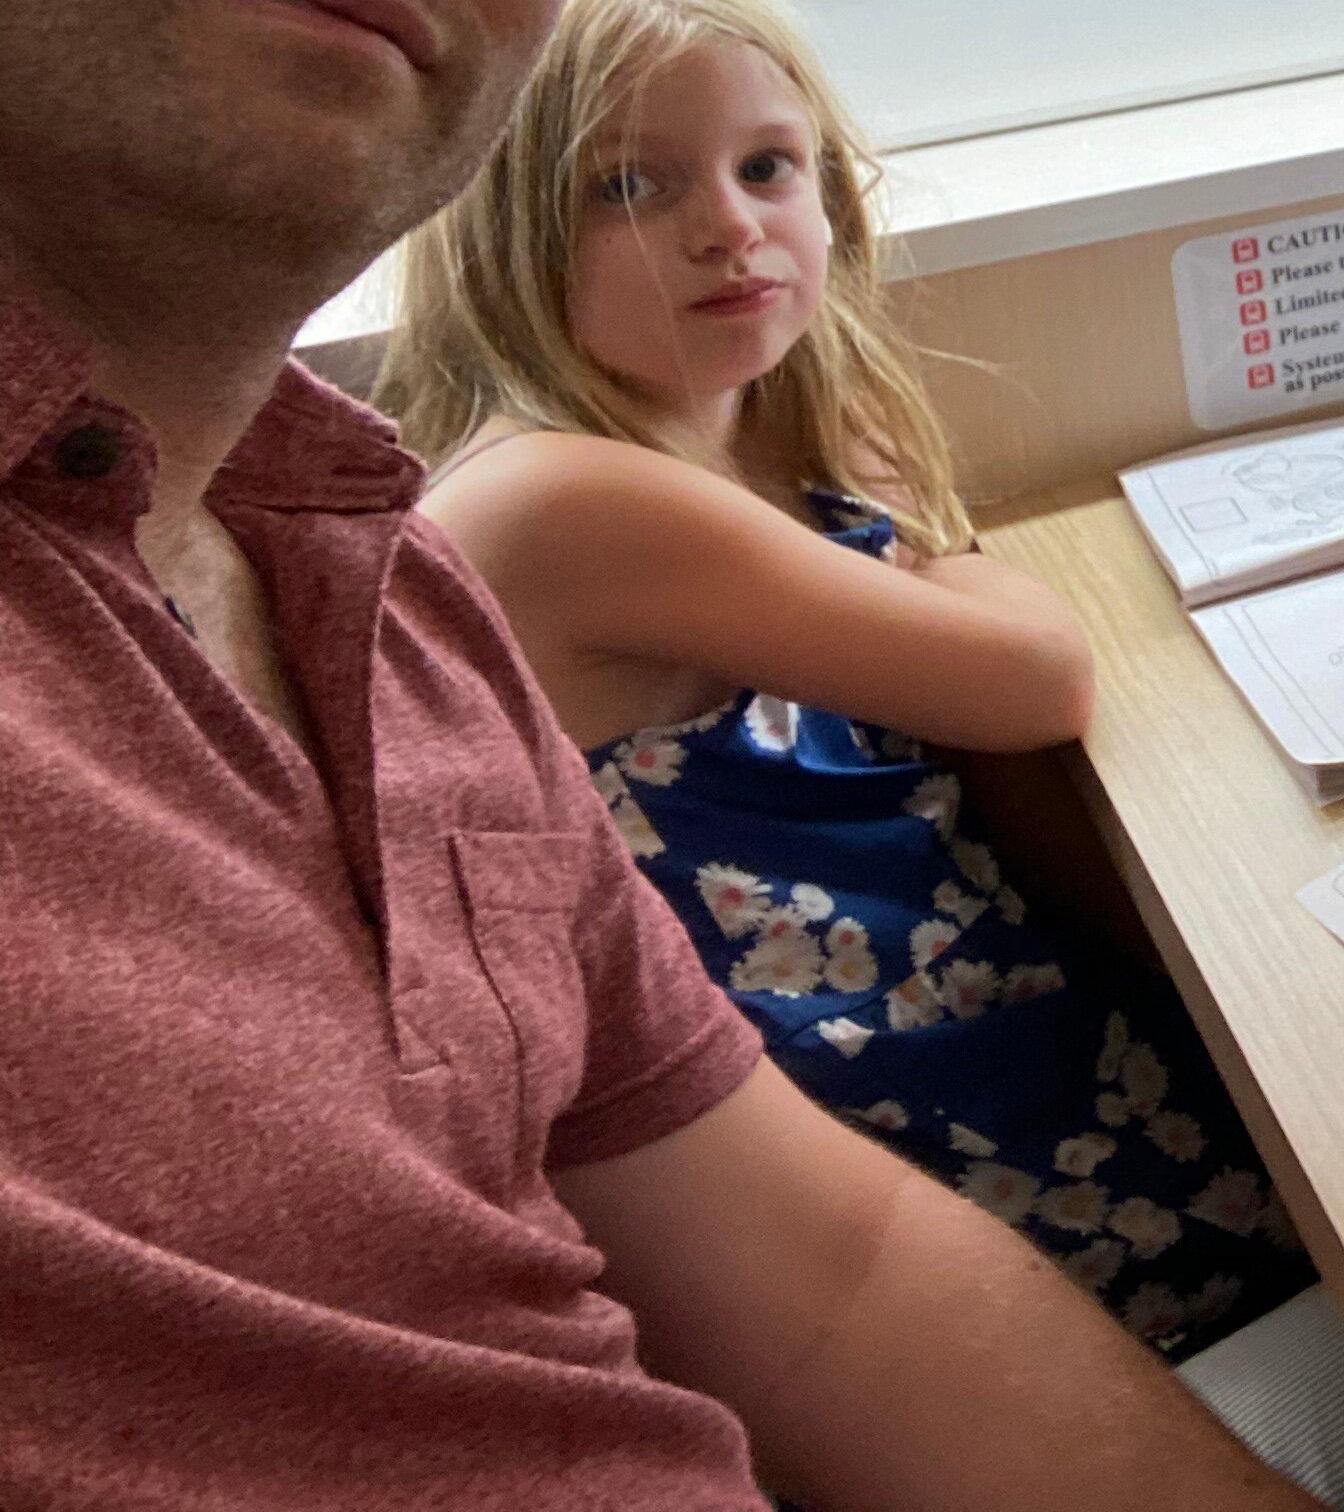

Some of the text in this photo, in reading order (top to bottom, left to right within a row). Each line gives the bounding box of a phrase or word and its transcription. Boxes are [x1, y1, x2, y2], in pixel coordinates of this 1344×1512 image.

[1271, 259, 1333, 285] Please
[1279, 319, 1340, 345] Please
[1284, 374, 1304, 393] as
